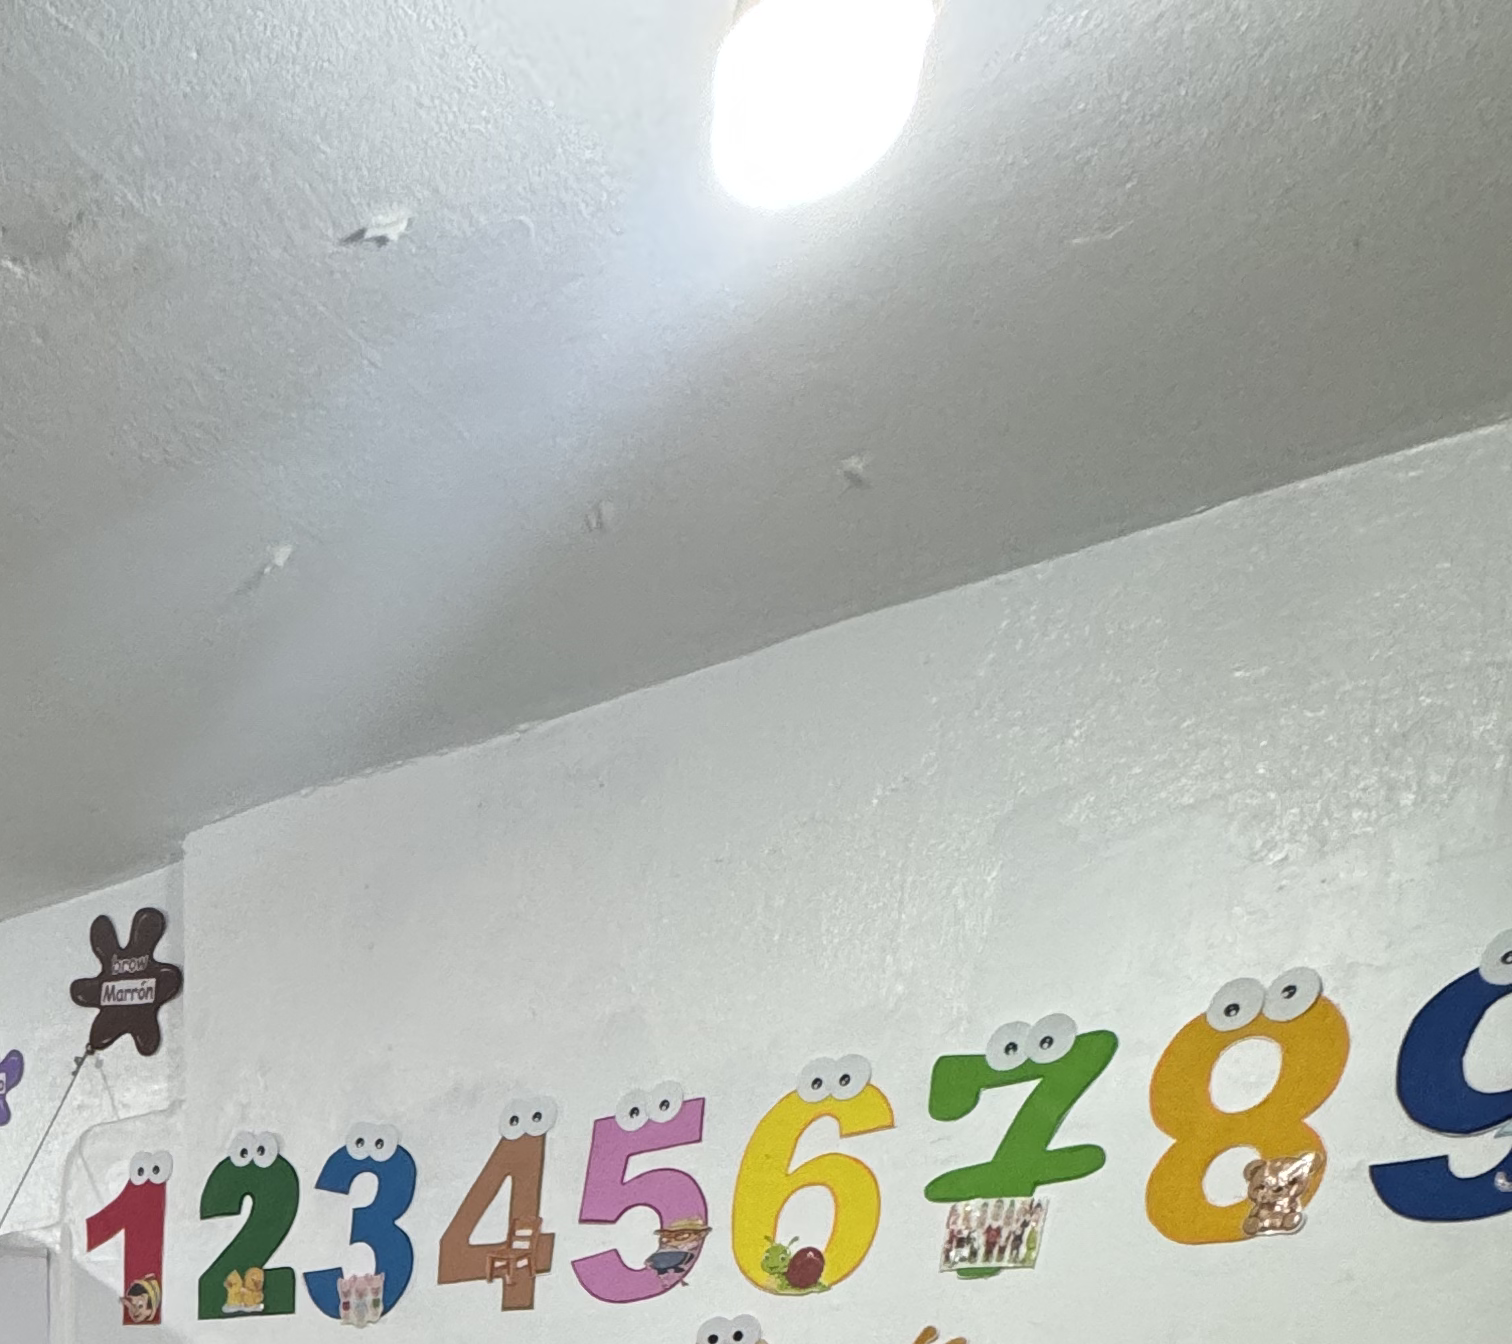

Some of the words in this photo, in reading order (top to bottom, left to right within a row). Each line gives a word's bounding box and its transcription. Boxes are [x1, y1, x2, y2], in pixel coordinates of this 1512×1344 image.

[112, 954, 149, 975] brow
[102, 980, 155, 1003] Marrón
[86, 1178, 167, 1325] 1
[198, 1153, 299, 1320] 2
[304, 1144, 417, 1320] 3
[438, 1131, 555, 1311] 4
[572, 1098, 708, 1304] 5
[732, 1084, 895, 1295] 6
[924, 1030, 1118, 1279] 7
[1145, 994, 1350, 1244] 8
